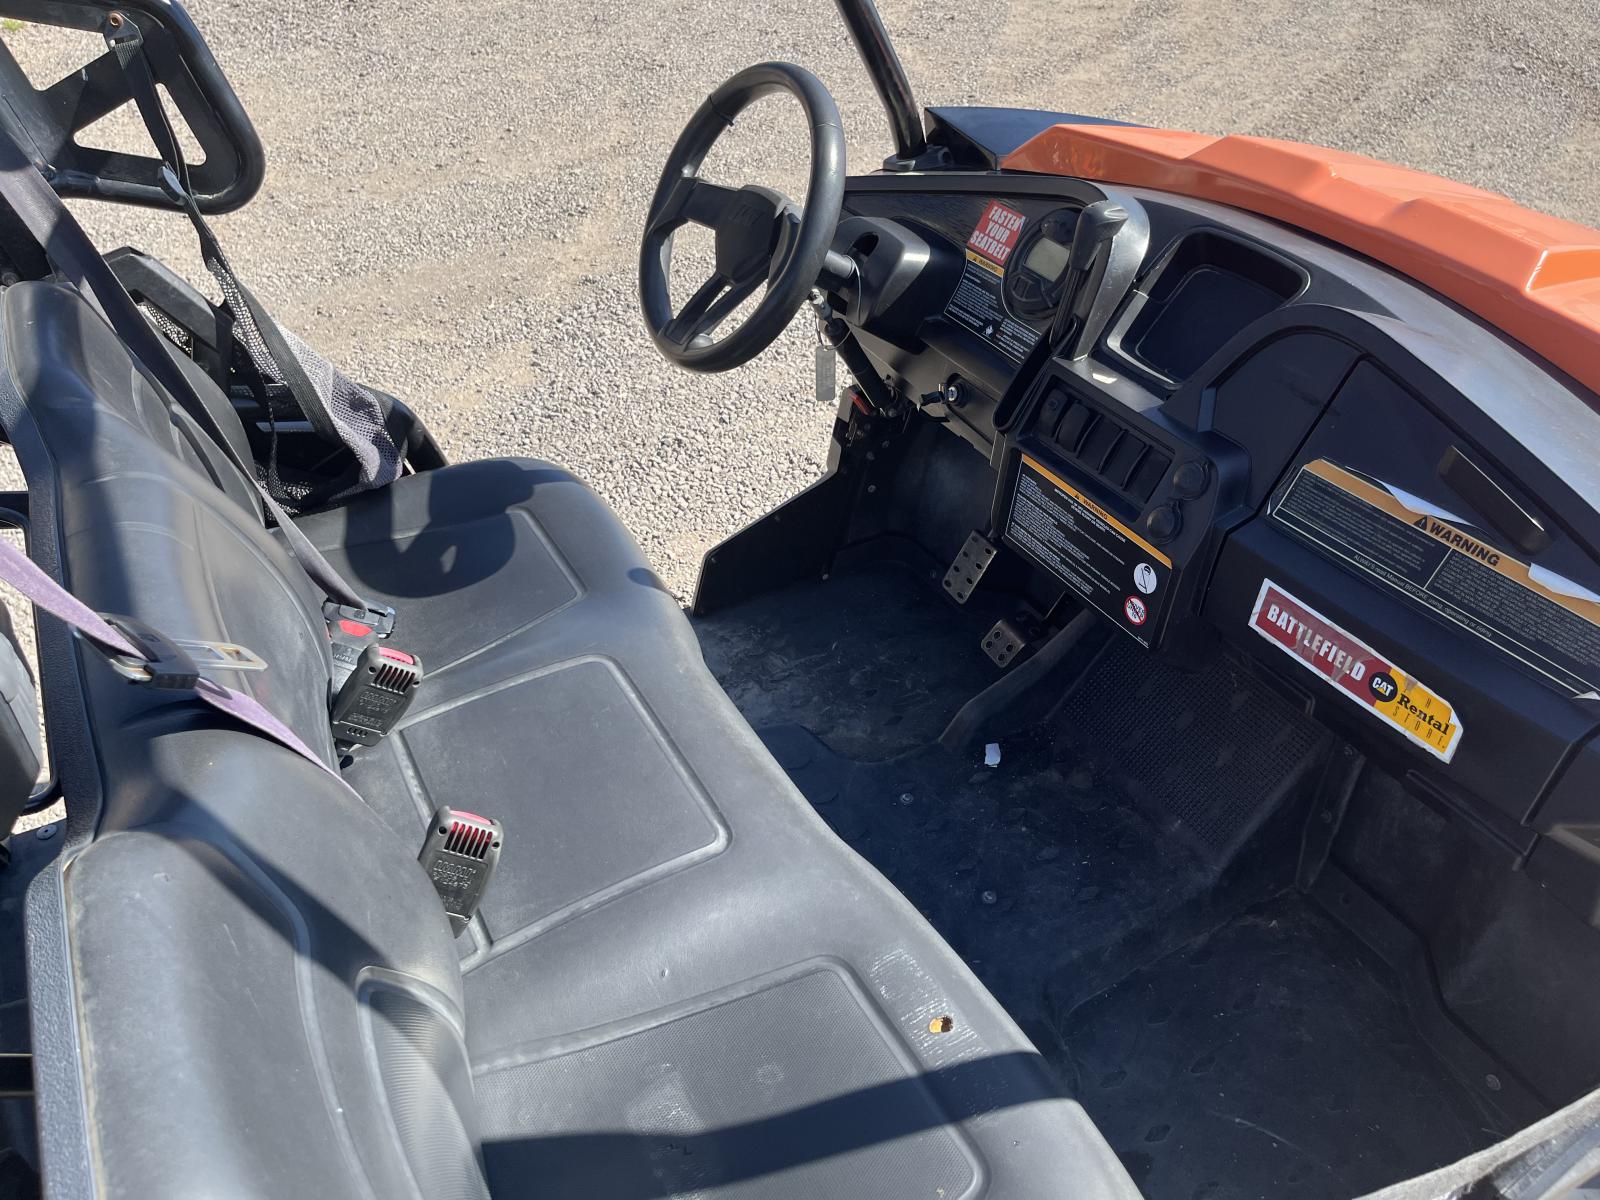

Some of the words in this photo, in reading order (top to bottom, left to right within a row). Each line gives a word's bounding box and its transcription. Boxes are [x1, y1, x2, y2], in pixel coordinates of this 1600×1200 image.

[985, 221, 1011, 243] YOUR
[989, 206, 1021, 231] FASTEN
[970, 230, 1011, 260] SEATBELT
[1083, 499, 1108, 520] WARNING
[1427, 522, 1500, 567] WARNING
[1353, 554, 1375, 569] ALWAYS
[1386, 573, 1404, 588] Manual
[1404, 583, 1428, 601] BEFORE
[1444, 607, 1470, 624] operating
[1266, 603, 1366, 683] BATTLEFIELD
[1372, 677, 1394, 697] CAT
[1397, 693, 1450, 735] Rental
